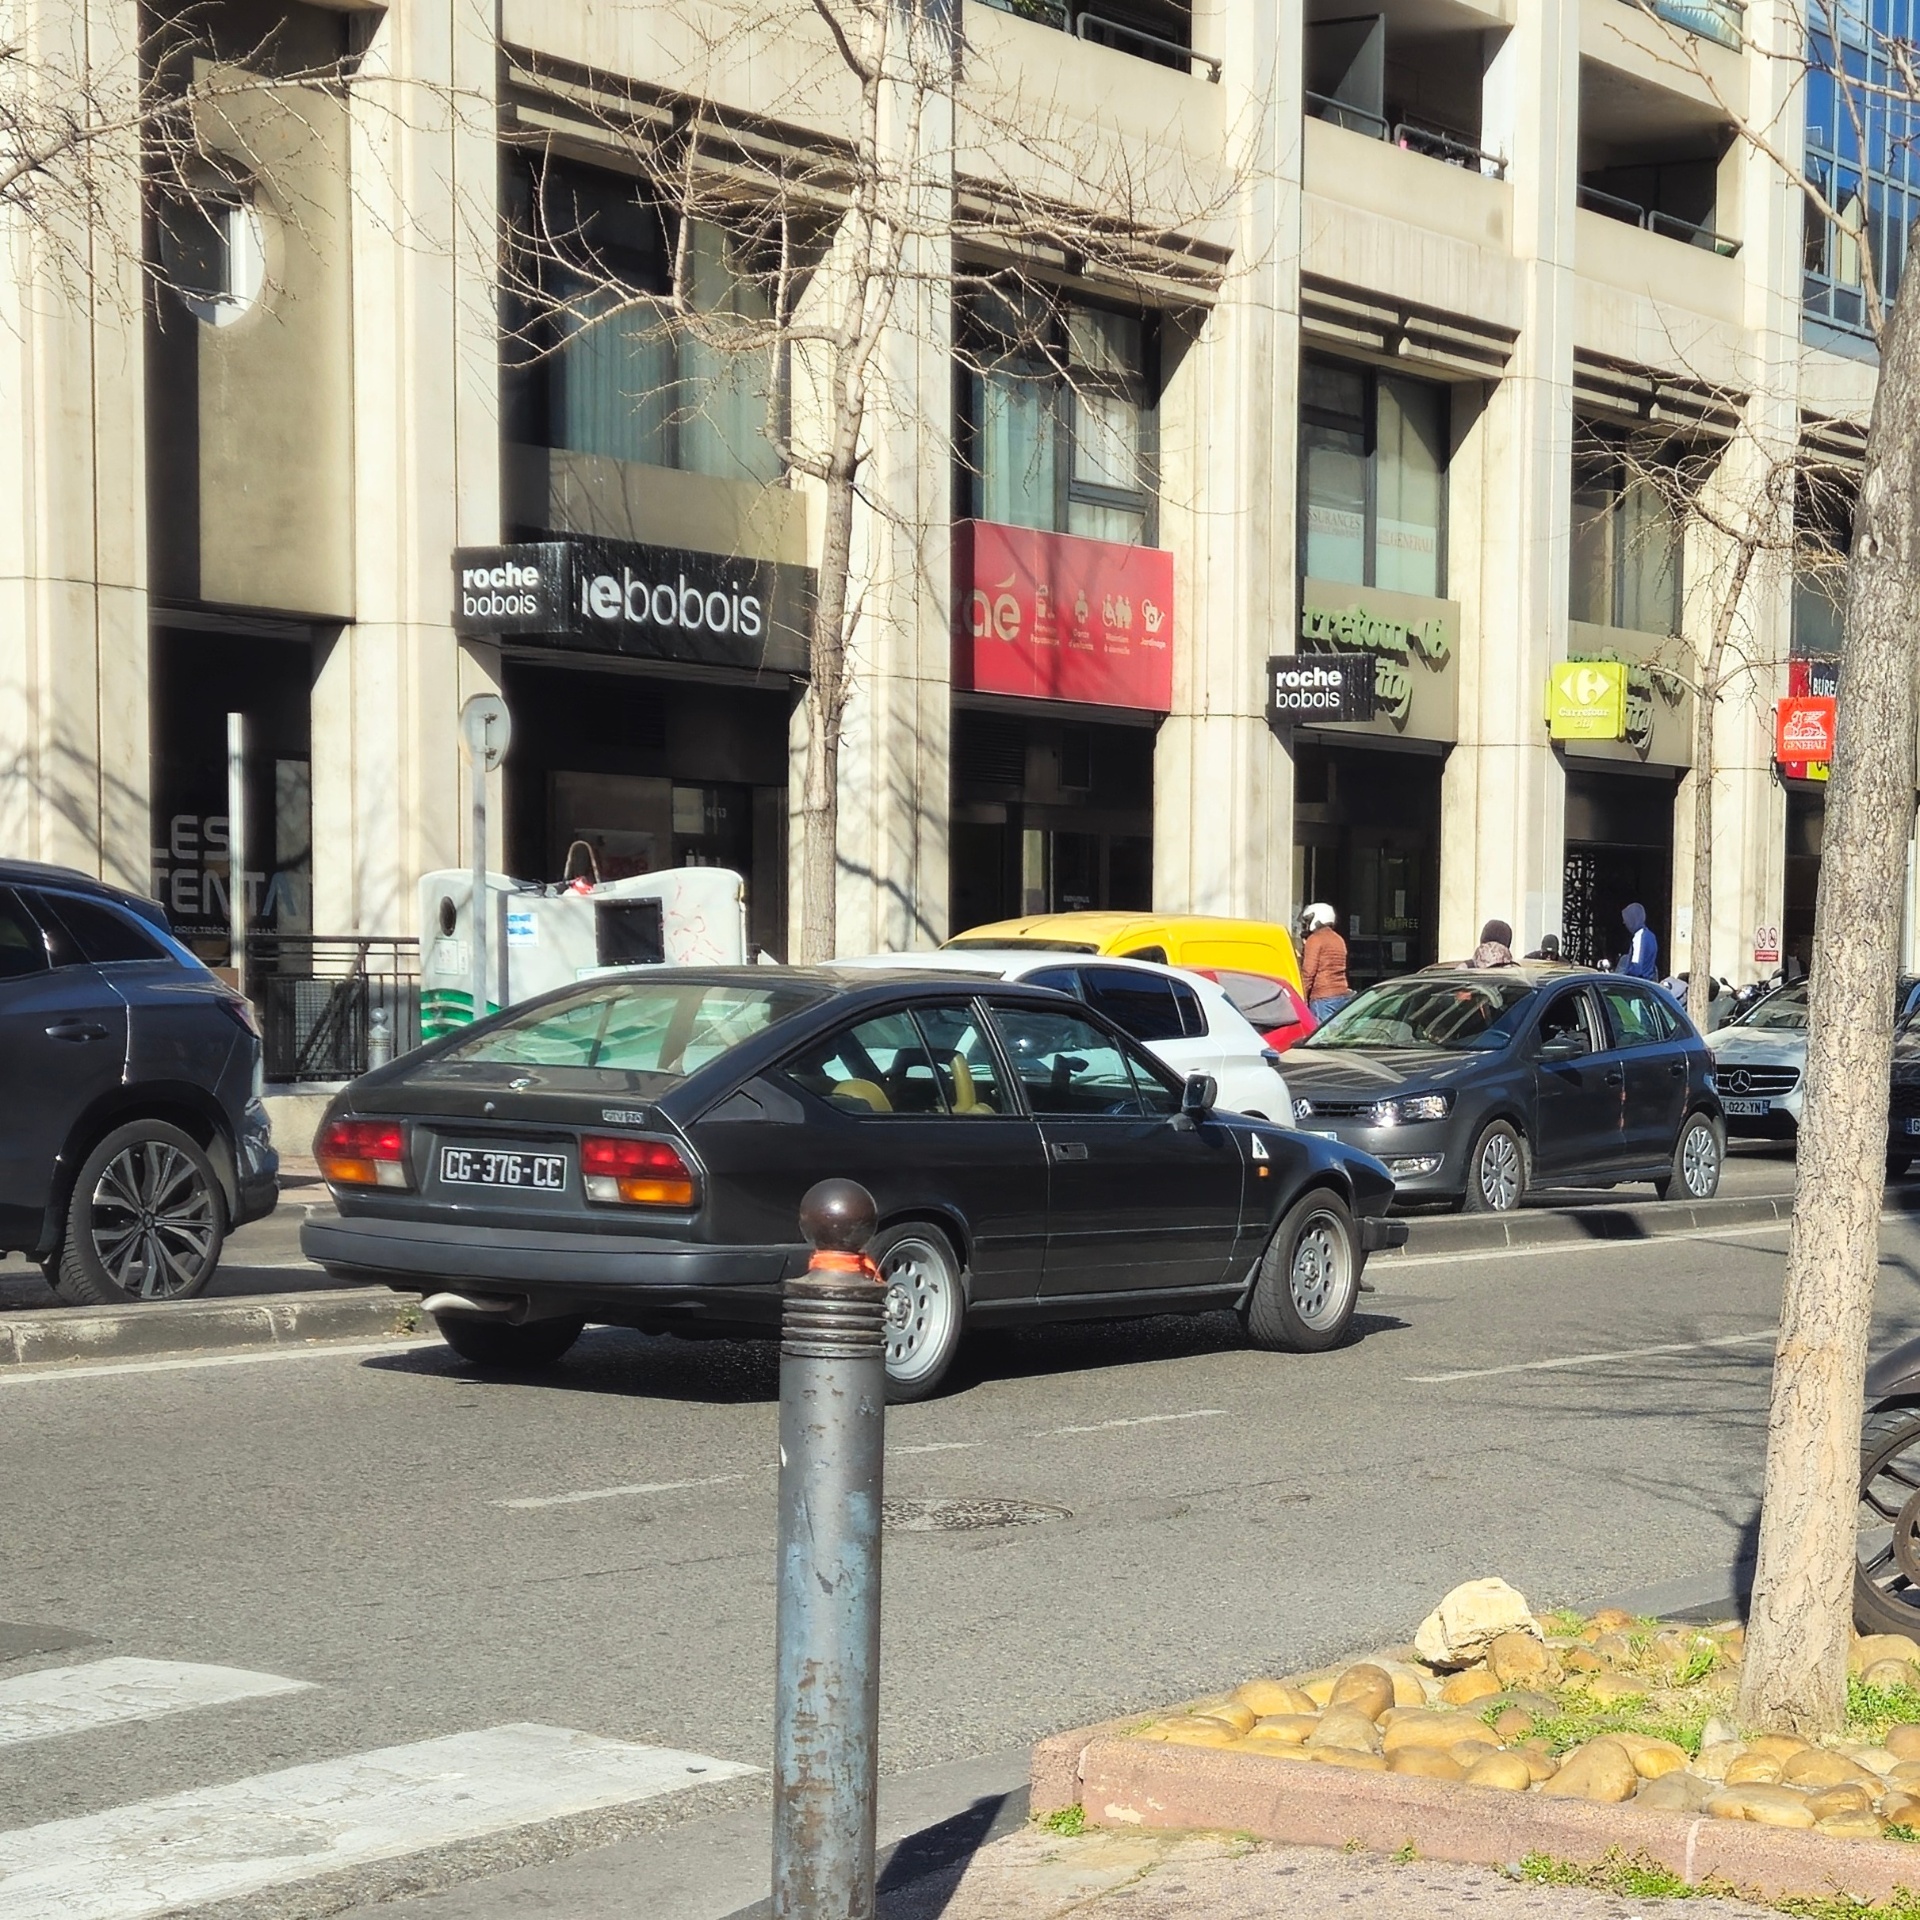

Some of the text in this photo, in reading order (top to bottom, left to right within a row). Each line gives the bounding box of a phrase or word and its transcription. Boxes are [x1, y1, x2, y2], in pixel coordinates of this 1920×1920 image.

[463, 562, 539, 588] roche
[463, 590, 537, 616] bobois
[1276, 667, 1342, 687] roche
[1276, 688, 1340, 708] bobois
[1559, 707, 1609, 717] Carrefour
[1783, 740, 1827, 751] GENERALI
[446, 1151, 561, 1187] CG-376-CC
